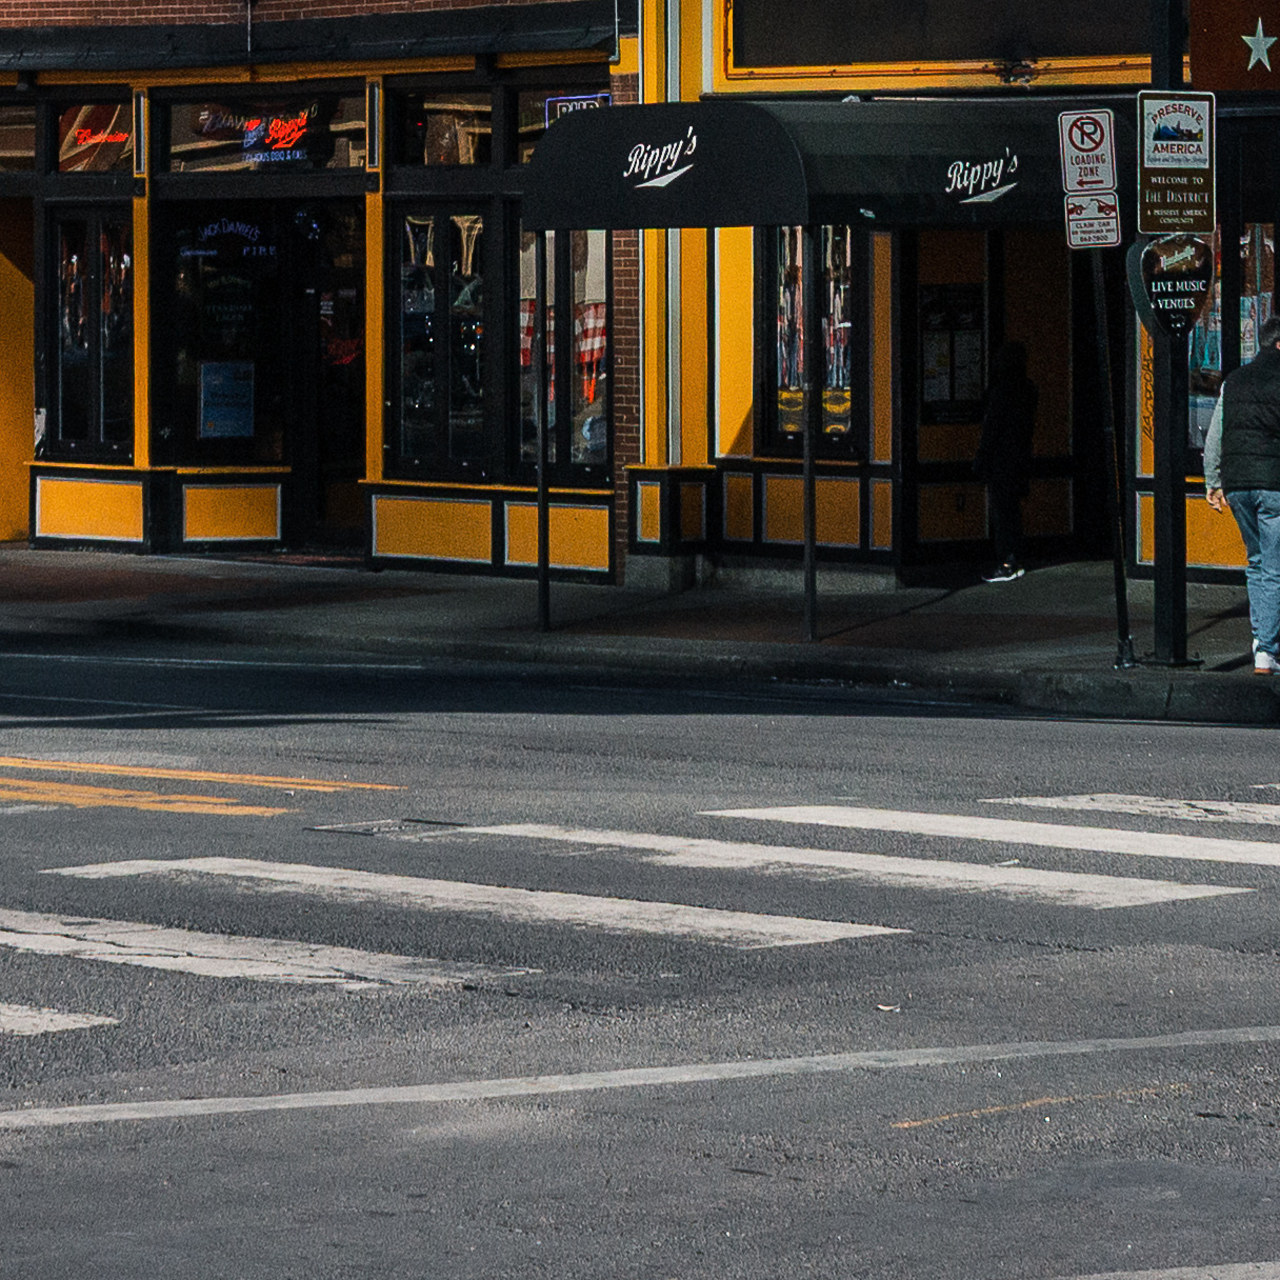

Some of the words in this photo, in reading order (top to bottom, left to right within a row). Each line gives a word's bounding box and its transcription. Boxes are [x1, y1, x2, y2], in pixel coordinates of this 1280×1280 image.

[1151, 103, 1204, 126] PRESERVE
[624, 125, 698, 180] Rippy's
[1152, 143, 1203, 155] AMERICA
[1070, 153, 1107, 166] LOADING
[945, 145, 1019, 195] Rippy's
[1078, 166, 1100, 178] ZONE
[1150, 176, 1188, 185] WELCOME
[1192, 176, 1204, 185] TO
[1151, 281, 1174, 292] LIVE
[1176, 280, 1207, 292] MUSIC
[1157, 297, 1196, 309] VENUES
